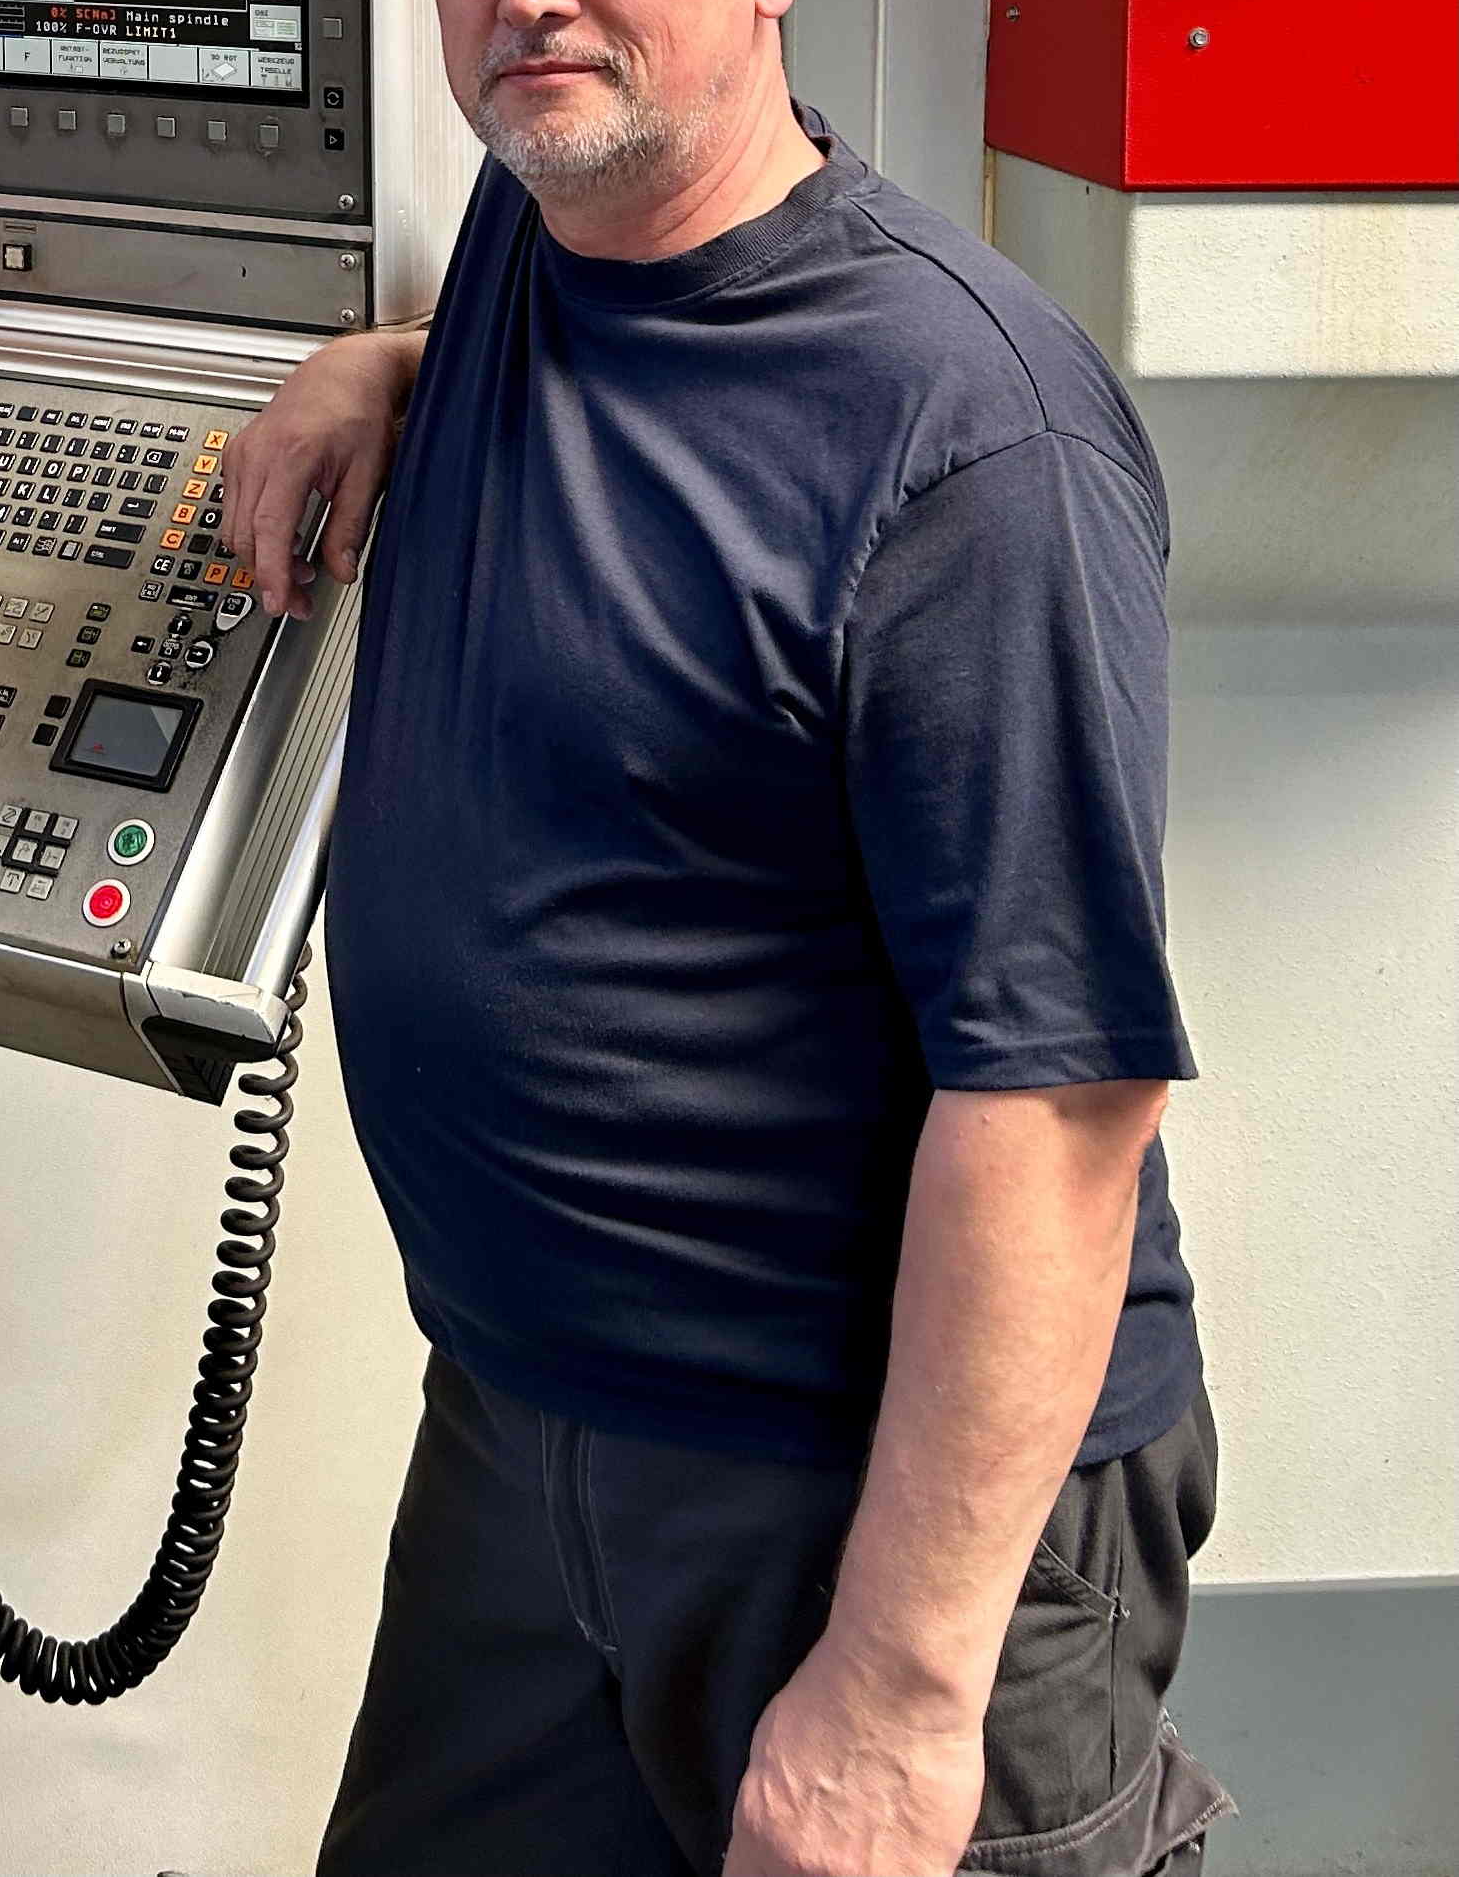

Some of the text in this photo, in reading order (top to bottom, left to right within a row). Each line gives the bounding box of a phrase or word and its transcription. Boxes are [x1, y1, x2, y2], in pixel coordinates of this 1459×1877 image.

[50, 7, 67, 18] 0%
[126, 11, 159, 23] Main
[169, 13, 229, 26] spindle
[36, 21, 176, 39] 100% F-OVR LIMIT1
[23, 51, 30, 61] F
[210, 435, 221, 445] X
[0, 455, 9, 466] U
[47, 463, 58, 474] O
[73, 466, 84, 477] P
[201, 460, 210, 469] Y
[18, 484, 29, 495] K
[42, 487, 51, 499] L
[190, 484, 201, 495] Z
[178, 509, 189, 518] B
[167, 534, 179, 544] C
[154, 558, 171, 572] CE
[210, 567, 221, 579] P
